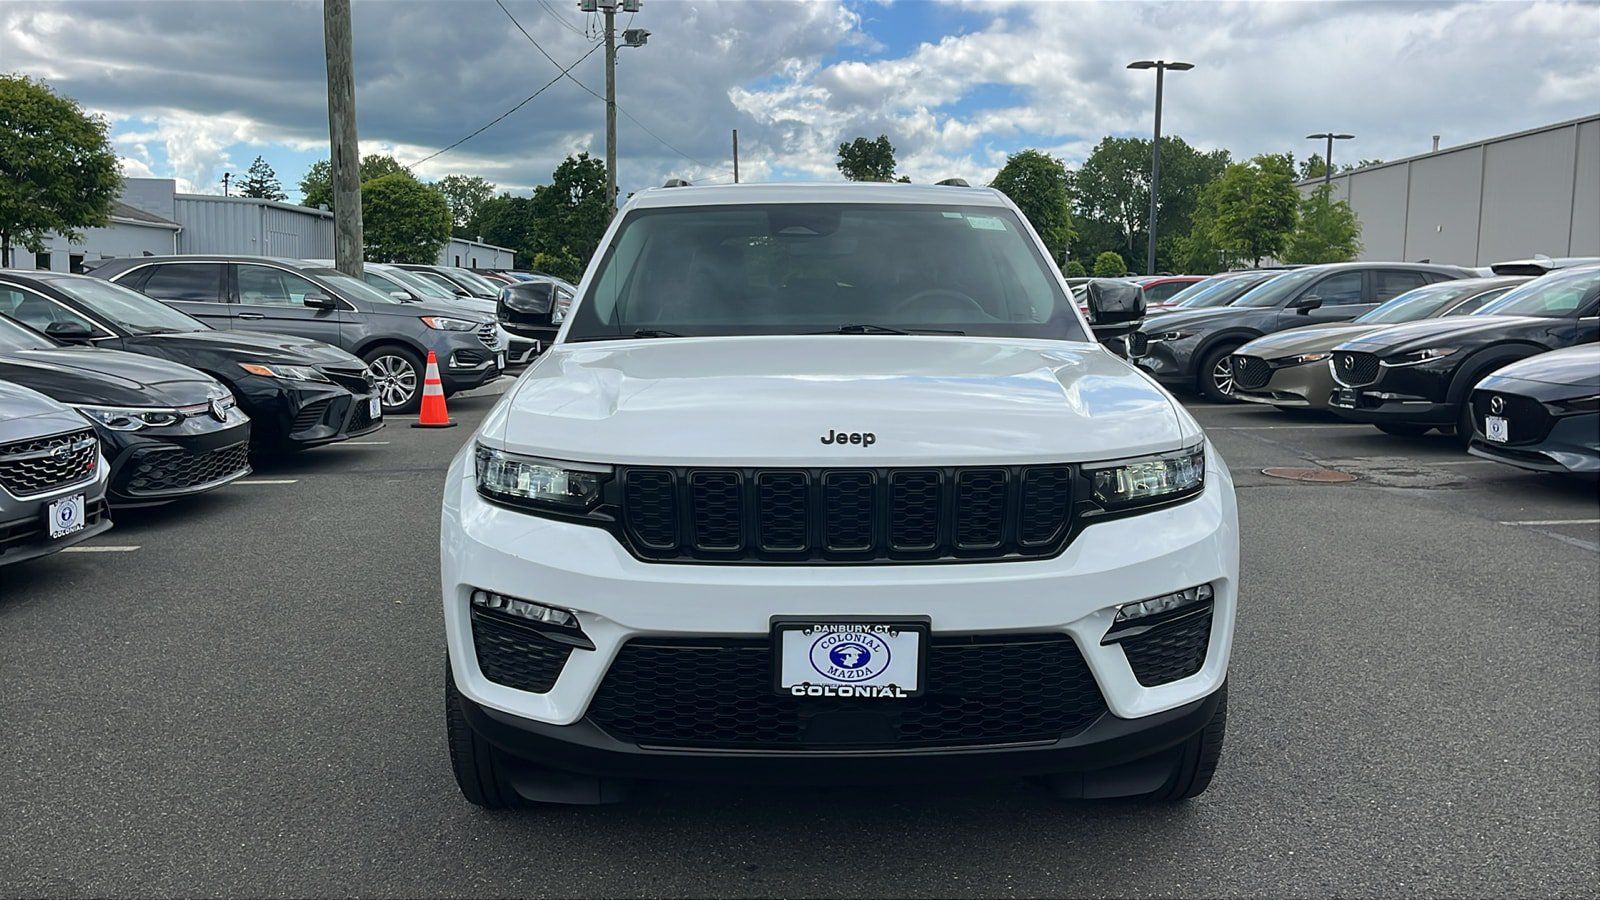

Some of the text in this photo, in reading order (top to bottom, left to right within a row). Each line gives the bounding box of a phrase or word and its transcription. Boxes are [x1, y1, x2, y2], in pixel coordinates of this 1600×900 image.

[821, 430, 876, 447] Jeep
[814, 625, 890, 633] DANBURY, CT
[821, 633, 880, 653] COLONIAL
[827, 666, 873, 679] MAZDA
[791, 686, 907, 698] COLONIAL
